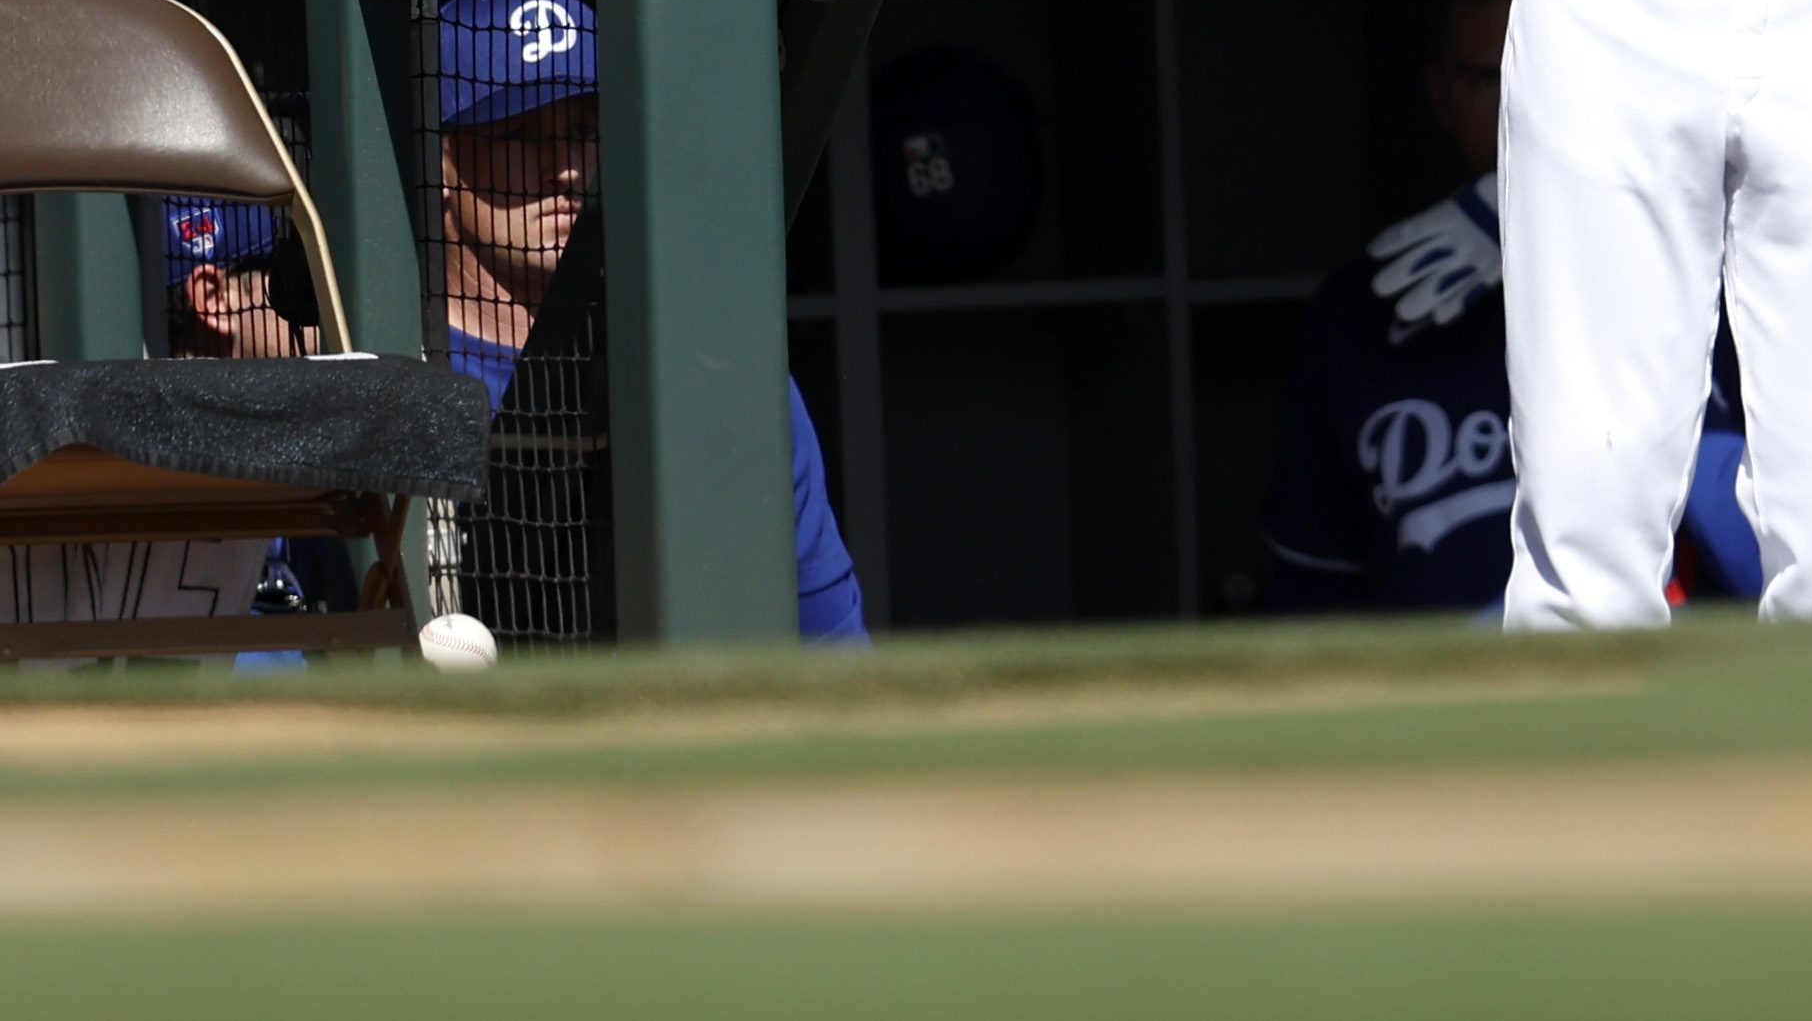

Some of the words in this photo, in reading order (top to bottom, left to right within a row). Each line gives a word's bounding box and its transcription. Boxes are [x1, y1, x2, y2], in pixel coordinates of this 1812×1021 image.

[509, 0, 577, 63] D
[908, 159, 955, 196] 68
[1357, 398, 1509, 516] Do
